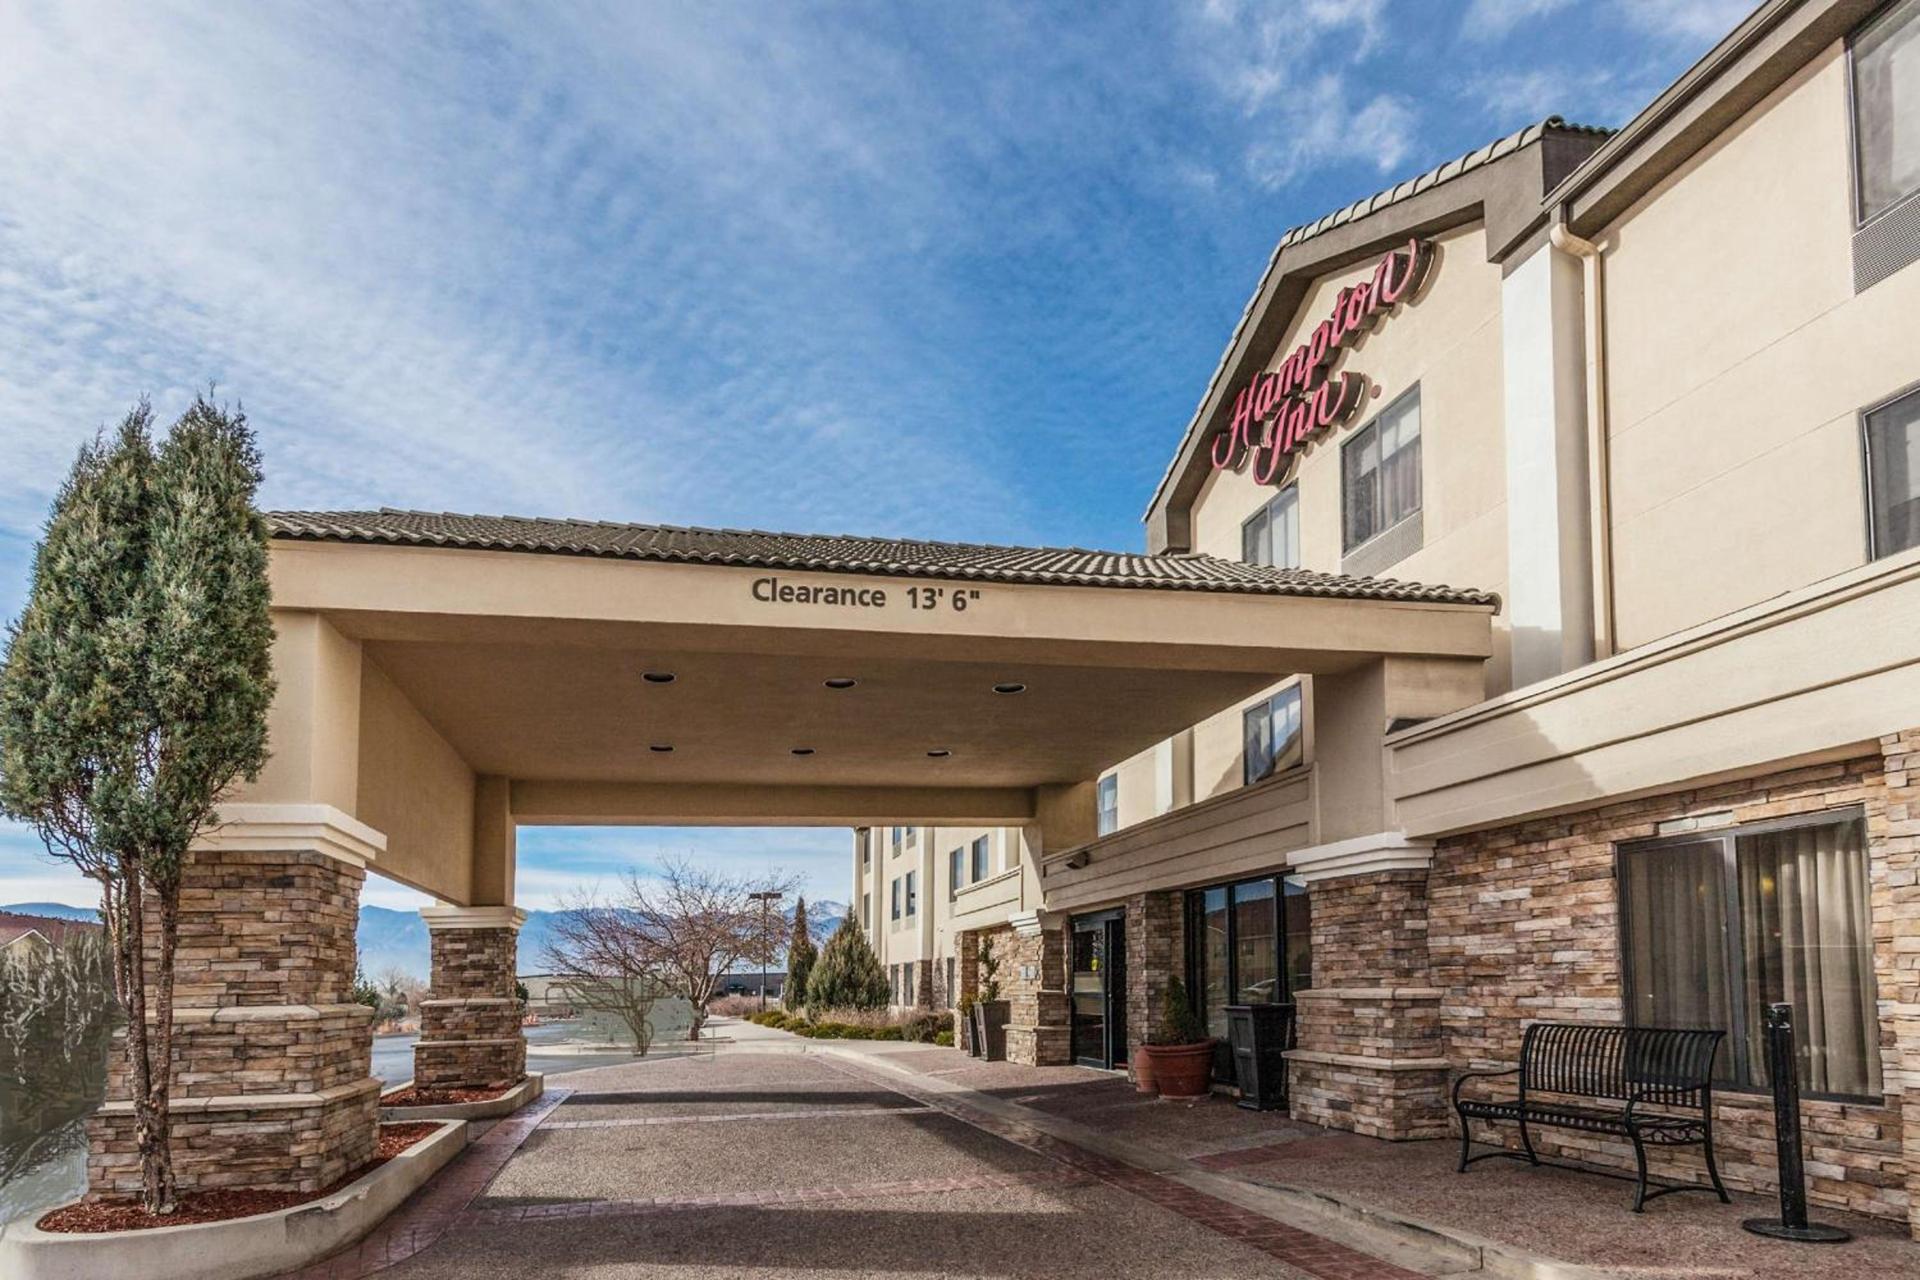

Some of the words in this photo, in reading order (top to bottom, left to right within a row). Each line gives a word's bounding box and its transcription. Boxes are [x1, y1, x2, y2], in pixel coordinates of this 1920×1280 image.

[1212, 238, 1428, 470] Hampton
[1253, 371, 1355, 484] Inn
[752, 577, 886, 607] Clearance
[906, 587, 944, 610] 13'
